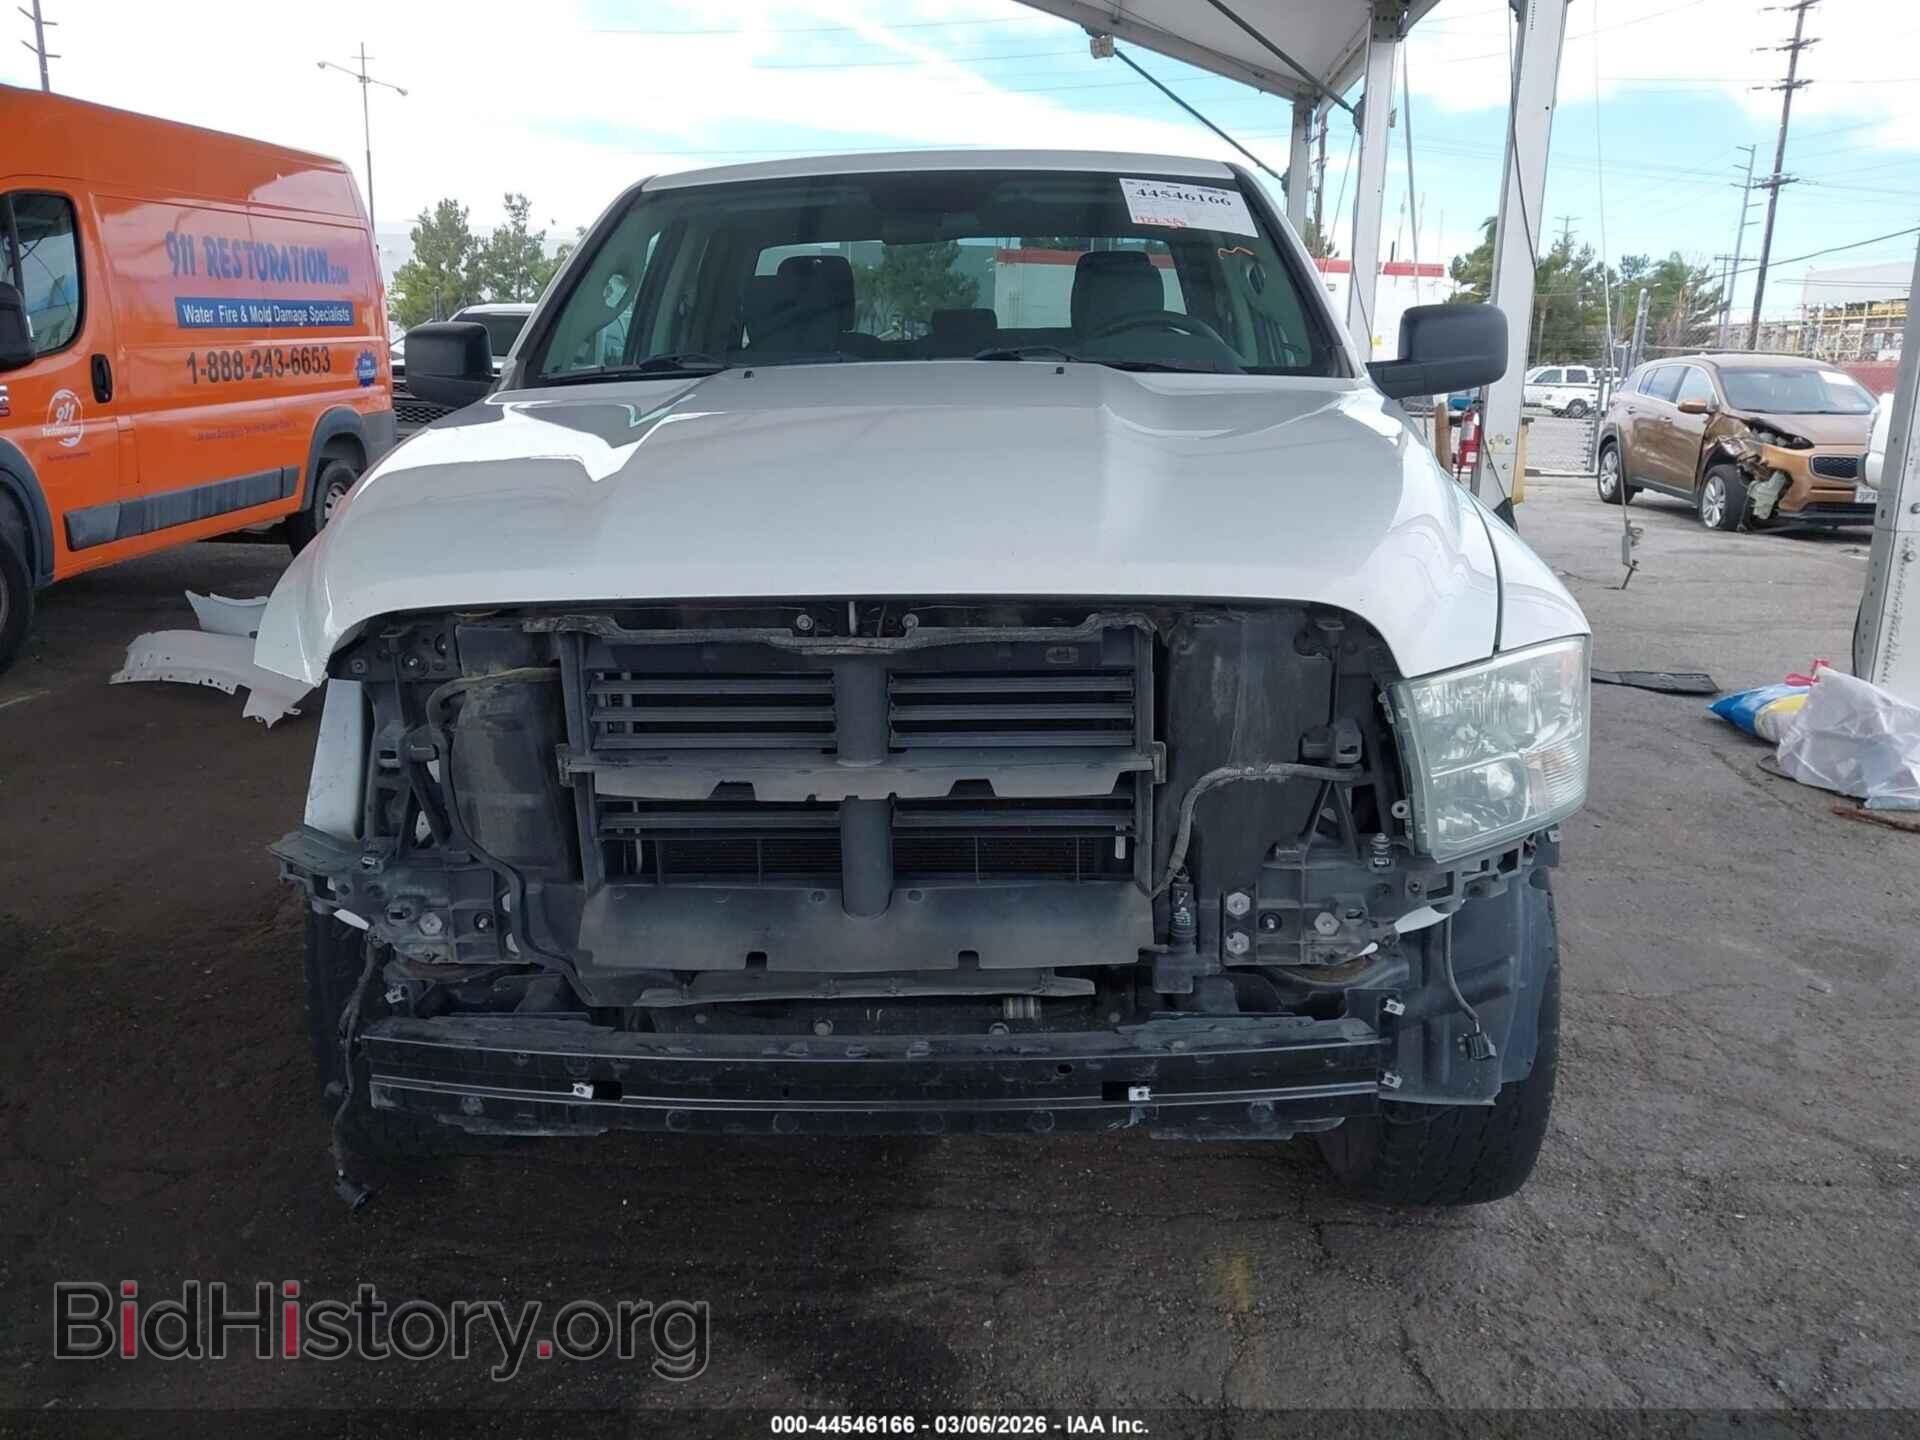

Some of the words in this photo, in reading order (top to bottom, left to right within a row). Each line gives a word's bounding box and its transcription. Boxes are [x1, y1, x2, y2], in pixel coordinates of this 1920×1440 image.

[1135, 188, 1232, 207] 44546166
[165, 231, 196, 277] 911
[182, 304, 214, 324] Water
[218, 304, 238, 323] Fire
[240, 305, 248, 322] &
[249, 304, 272, 323] Mold
[273, 305, 308, 326] Damage
[309, 306, 350, 326] Specialists
[186, 346, 331, 384] 1-888-243-6653
